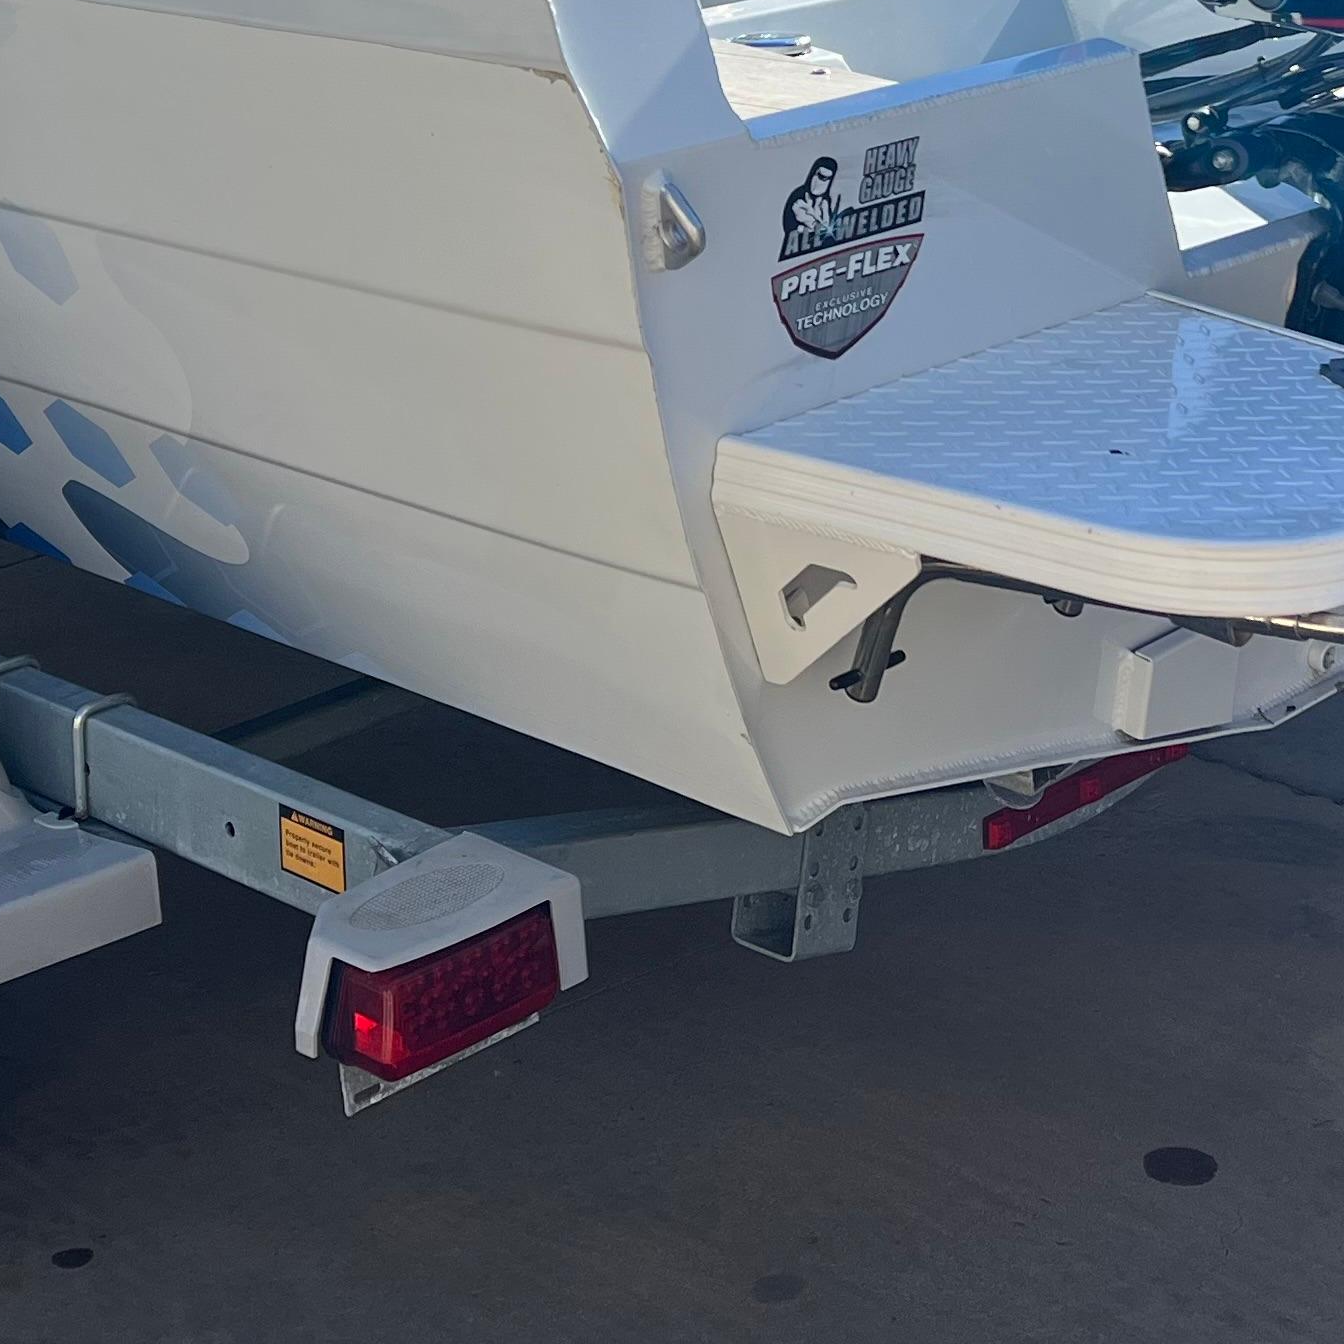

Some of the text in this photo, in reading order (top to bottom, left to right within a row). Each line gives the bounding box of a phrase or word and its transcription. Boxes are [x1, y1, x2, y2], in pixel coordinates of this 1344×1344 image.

[863, 136, 920, 176] HEAVY
[859, 163, 916, 204] GAUGE
[835, 197, 921, 242] WELDED
[781, 243, 913, 301] PRE-FLEX
[796, 292, 889, 331] TECHNOLOGY
[815, 286, 873, 311] EXCLUSIVE
